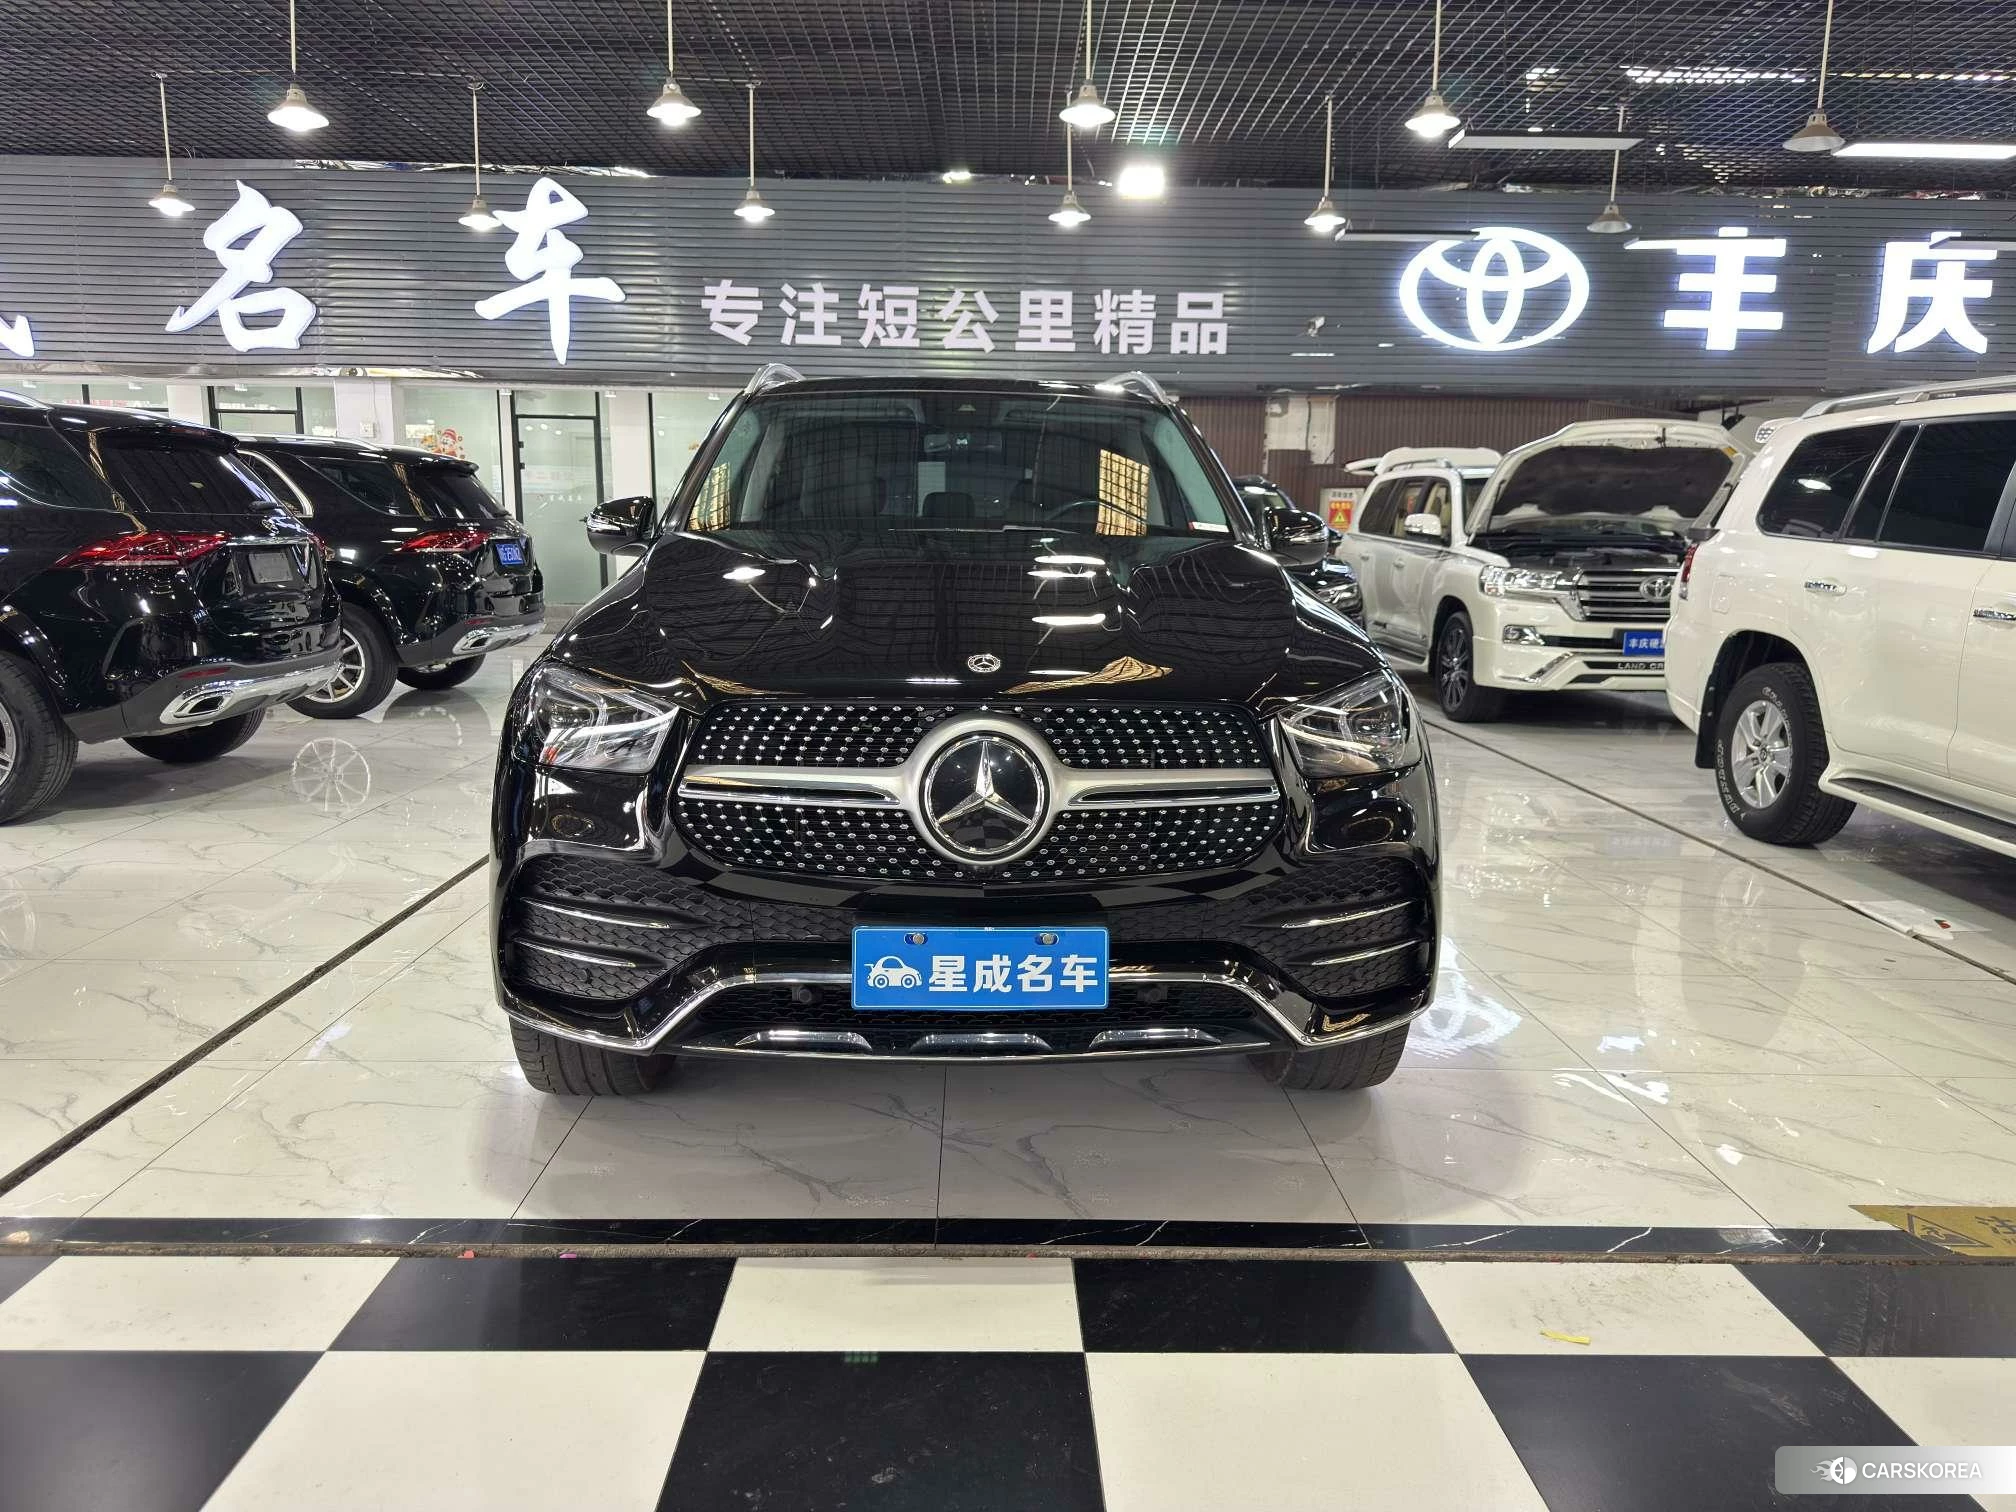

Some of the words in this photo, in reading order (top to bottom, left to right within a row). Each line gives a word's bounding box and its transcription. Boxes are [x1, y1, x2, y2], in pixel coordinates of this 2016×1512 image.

[1663, 227, 1998, 354] 丰庆
[700, 279, 1229, 355] 专注短公里精品
[1628, 638, 1664, 649] 丰庆硬
[1617, 662, 1646, 670] LAND
[928, 954, 1099, 993] 星成名车
